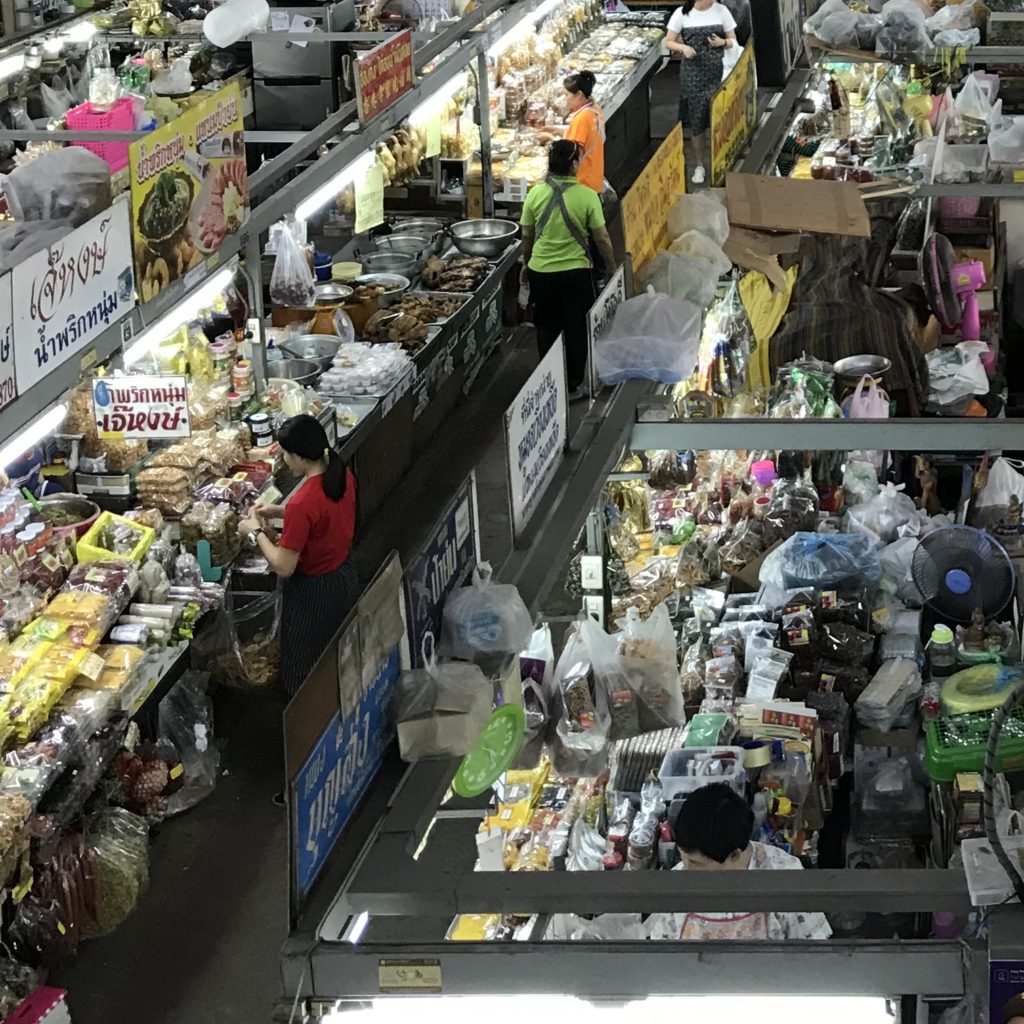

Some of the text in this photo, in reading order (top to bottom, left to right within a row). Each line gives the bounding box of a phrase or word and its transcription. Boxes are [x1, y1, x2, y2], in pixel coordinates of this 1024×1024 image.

[33, 291, 118, 368] น้ำพริกหนุ่ม
